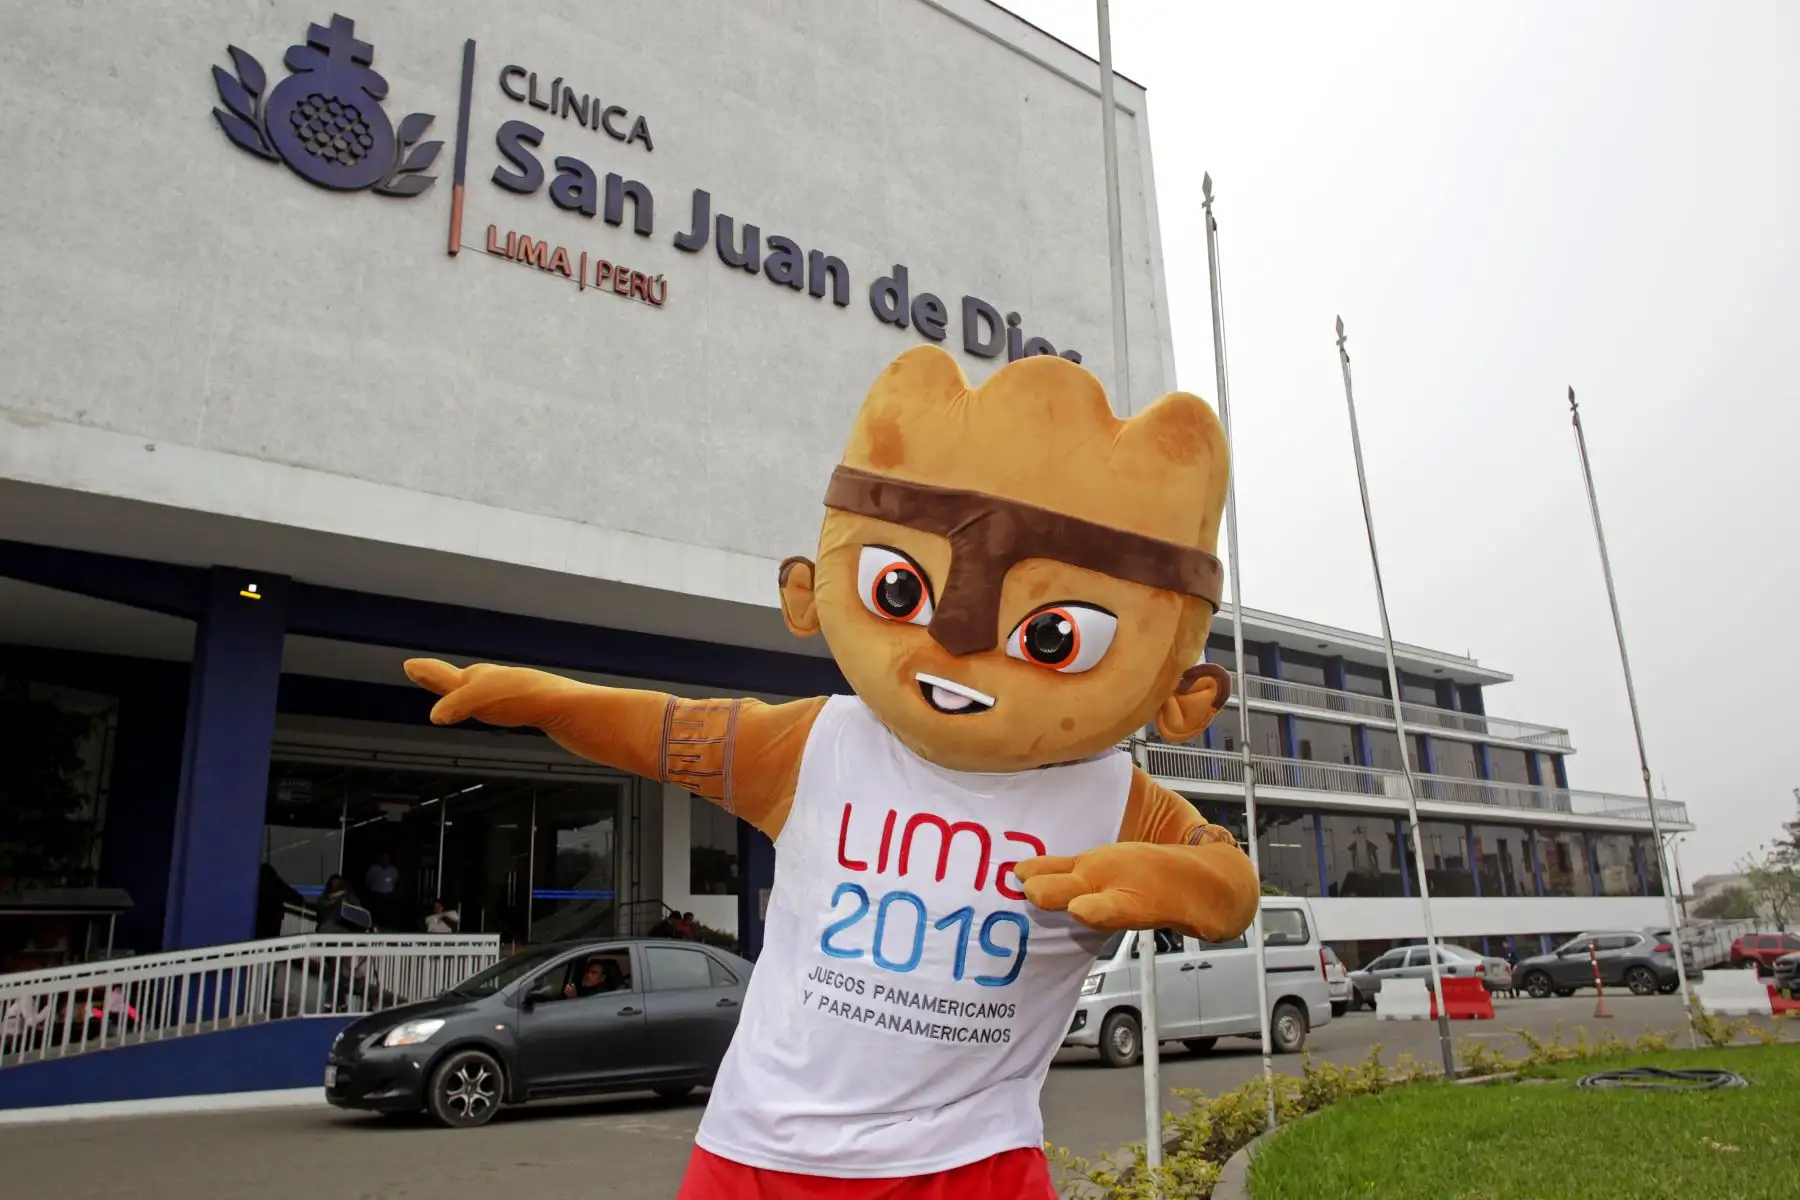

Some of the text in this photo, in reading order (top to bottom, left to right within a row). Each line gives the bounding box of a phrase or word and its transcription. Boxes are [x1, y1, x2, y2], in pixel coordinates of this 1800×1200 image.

[500, 64, 654, 152] CLÍNICA
[486, 224, 572, 277] LIMA
[596, 259, 668, 306] PERÚ
[491, 120, 654, 238] San
[674, 188, 850, 308] Juan
[870, 264, 948, 341] de
[820, 881, 1030, 988] 2019
[802, 989, 1012, 1044] Y PARAPANAMERICANOS
[808, 966, 1016, 1019] JUEGOS PANAMERICANOS
